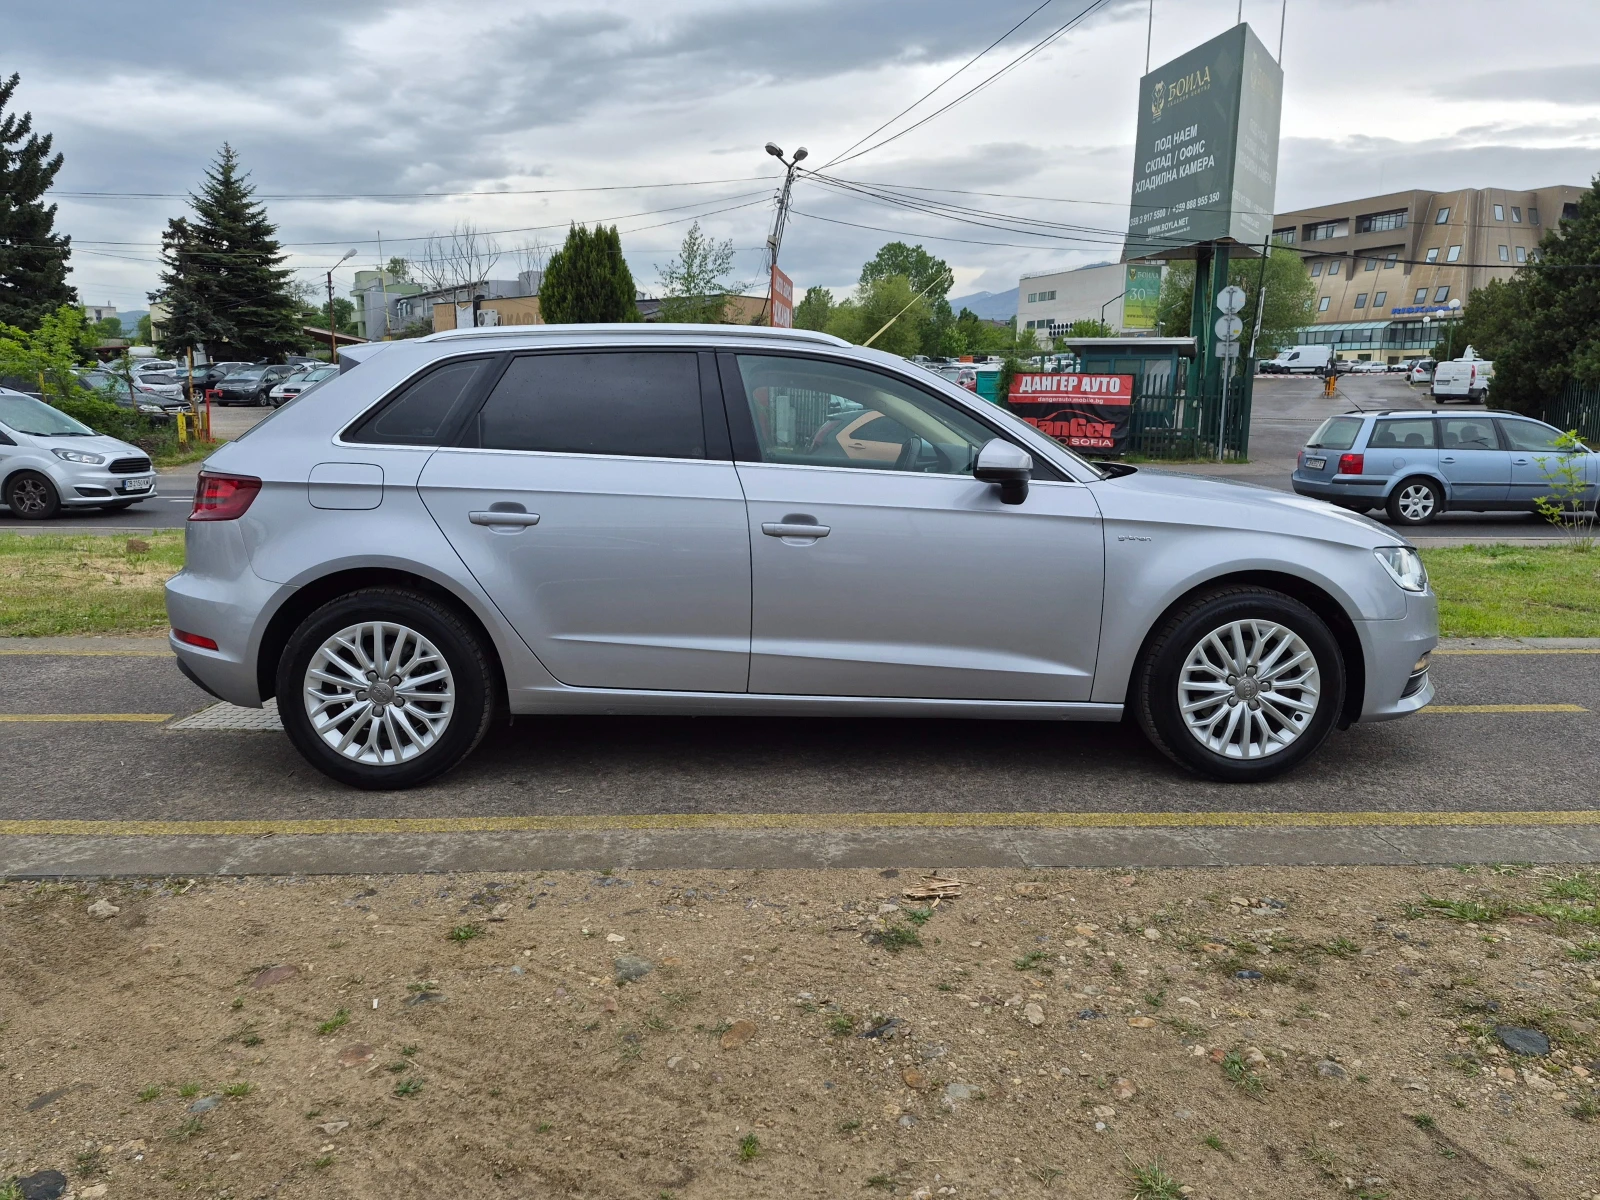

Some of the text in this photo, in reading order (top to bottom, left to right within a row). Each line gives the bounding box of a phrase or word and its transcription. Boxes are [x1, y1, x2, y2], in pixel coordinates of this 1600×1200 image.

[1167, 65, 1211, 101] БОИЛА
[1154, 124, 1198, 153] ПОД НАЕМ
[1145, 153, 1172, 173] СКЛАД
[1179, 140, 1206, 160] ОФИС
[1135, 168, 1178, 194] ХЛАДИЛНА
[1179, 154, 1215, 178] КАМЕРА
[1139, 215, 1143, 224] 2
[1143, 212, 1153, 223] 917
[1153, 208, 1166, 220] 5500
[1186, 198, 1197, 210] 888
[1197, 194, 1209, 207] 955
[1208, 191, 1220, 204] 350
[1147, 216, 1189, 235] WWW.BOYLA.NET
[1129, 287, 1146, 301] 30
[1019, 376, 1120, 393] ДАНГЕР АУТО
[1038, 396, 1104, 404] dangerauto.mobile.bg
[1071, 438, 1112, 446] SOFIA
